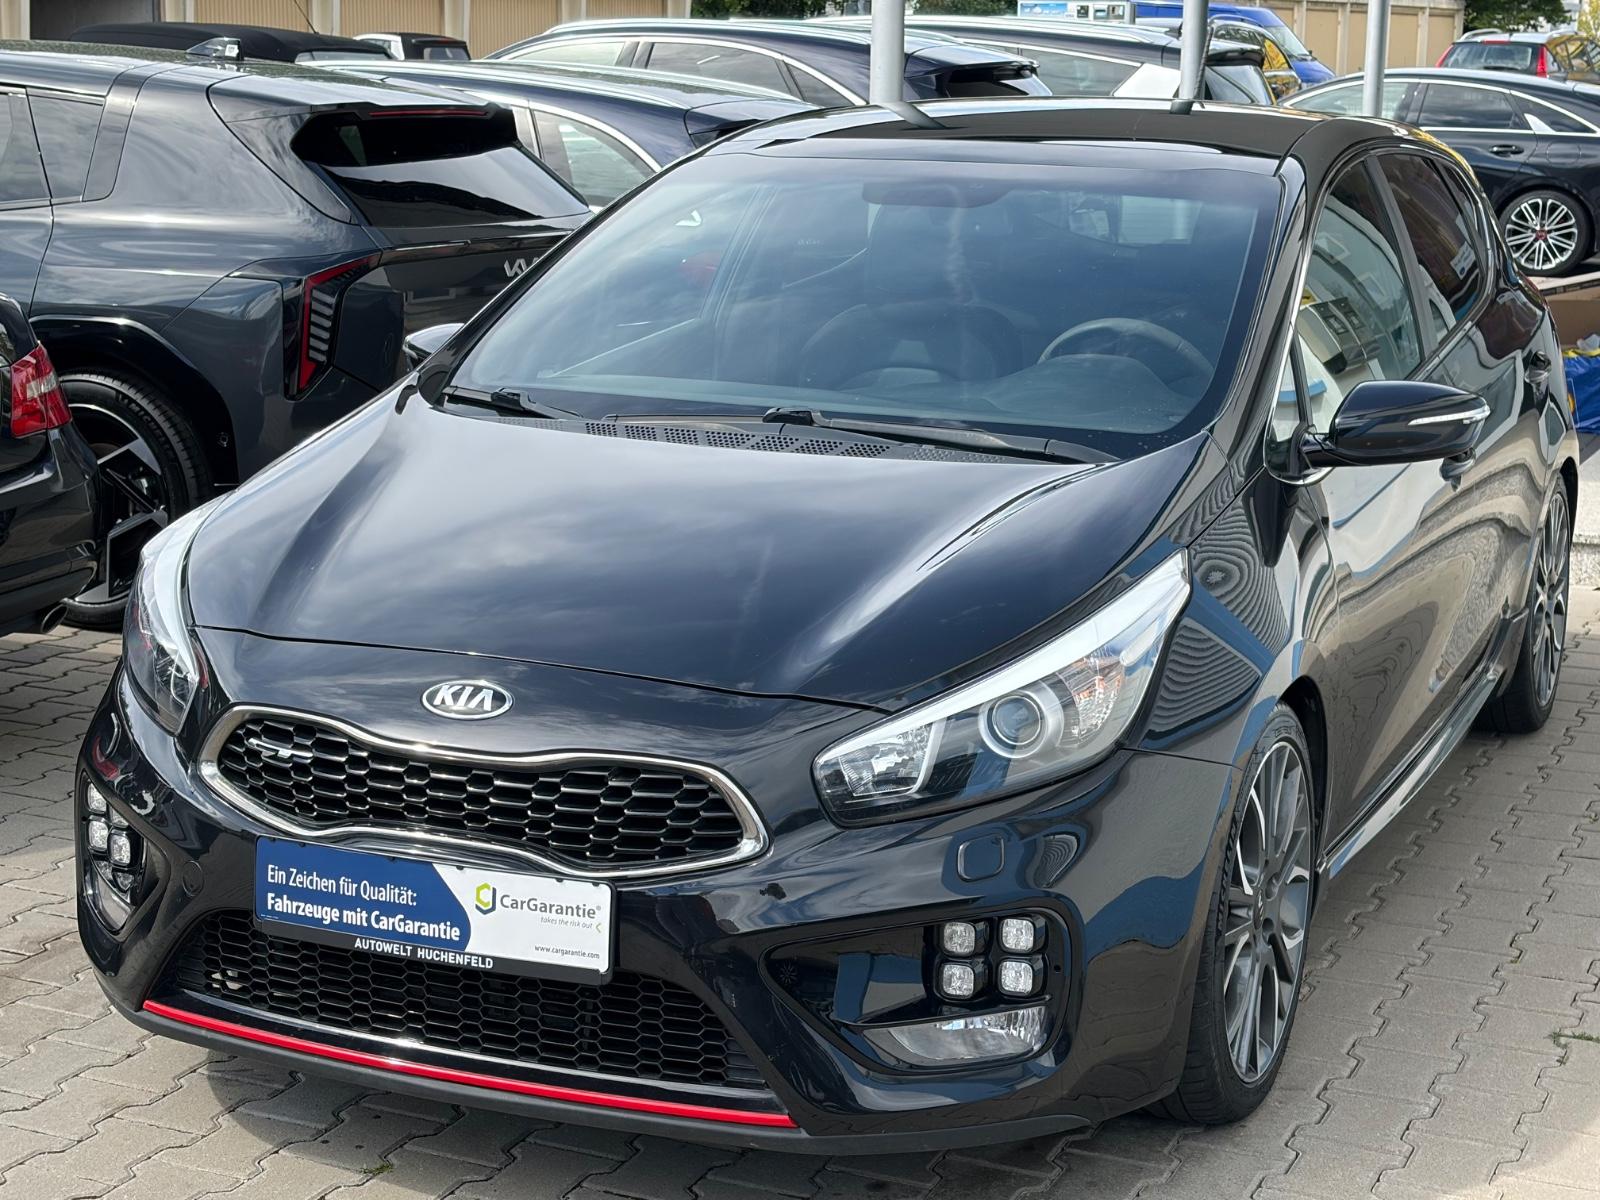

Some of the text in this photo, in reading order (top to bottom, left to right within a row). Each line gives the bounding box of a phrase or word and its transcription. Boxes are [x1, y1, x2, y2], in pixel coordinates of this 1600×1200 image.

[433, 684, 494, 711] KIA
[267, 864, 417, 907] Ein Zeichen für Qualität:
[267, 892, 460, 941] Fahrzeuge mit CarGarantie
[540, 916, 558, 925] takes
[559, 918, 569, 926] the
[569, 919, 581, 928] risk
[354, 937, 494, 969] AUTOWELT HUCHENFELD
[534, 945, 600, 959] www.cargarantie.com
